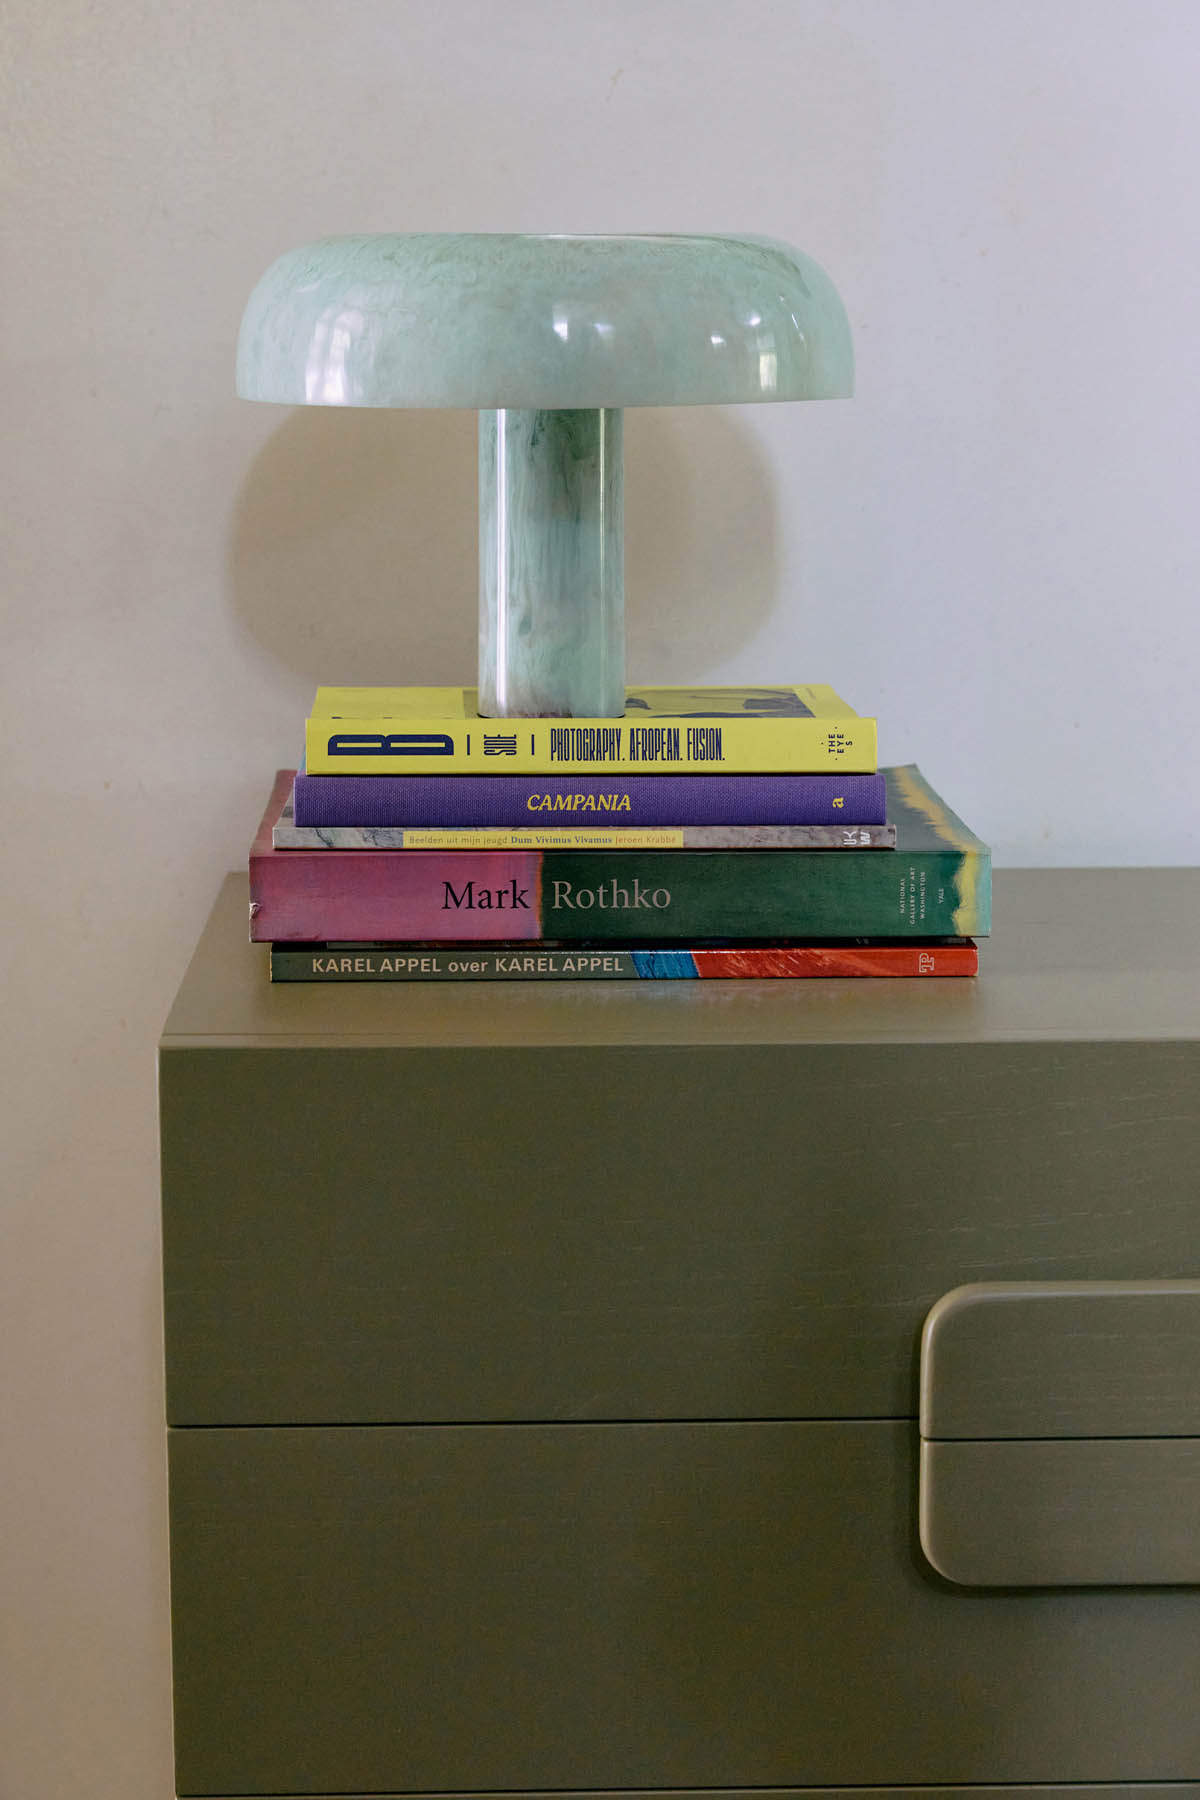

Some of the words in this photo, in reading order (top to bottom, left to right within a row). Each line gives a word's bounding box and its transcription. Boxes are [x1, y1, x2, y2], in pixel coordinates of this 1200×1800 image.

[328, 734, 454, 755] B
[551, 728, 625, 761] PHOTOGRAPHY.
[629, 728, 683, 761] AFROPEAN.
[687, 728, 725, 761] FUSION.
[828, 733, 836, 753] THE
[527, 794, 632, 811] CAMPANIA
[832, 797, 844, 808] a
[409, 836, 443, 844] Beelden
[447, 836, 458, 844] uit
[461, 836, 481, 846] mijn
[484, 836, 508, 846] jeugd
[511, 836, 533, 844] Dum
[536, 836, 572, 844] Vivimus
[575, 836, 612, 844] Vivamus
[615, 836, 642, 845] Jeroen
[442, 880, 531, 909] Mark
[552, 879, 672, 909] Rothko
[910, 882, 916, 892] OF
[312, 958, 375, 972] KAREL
[380, 958, 441, 972] APPEL
[448, 961, 488, 973] over
[495, 957, 557, 972] KAREL
[563, 957, 623, 972] APPEL
